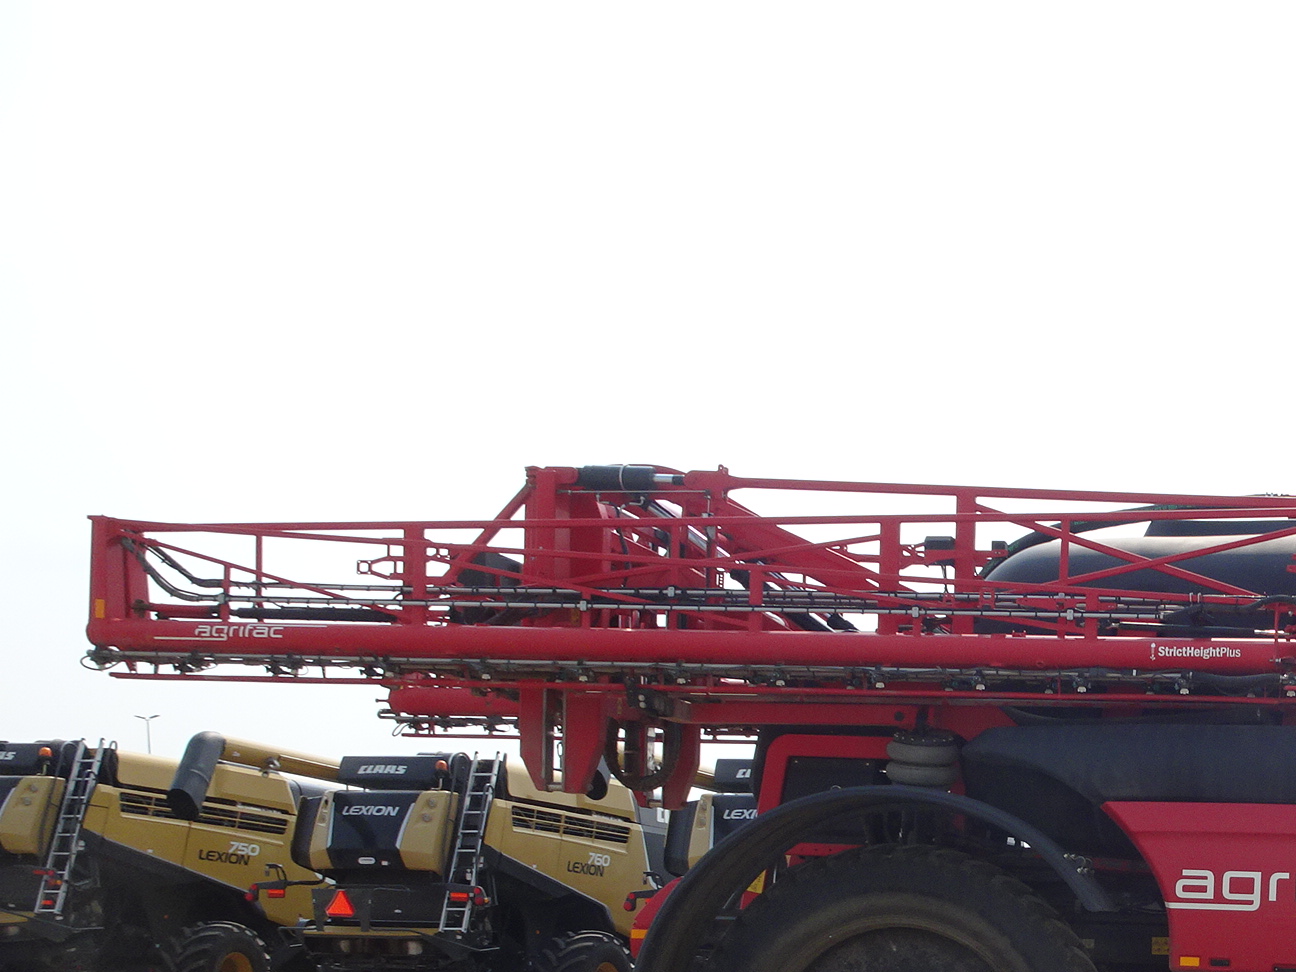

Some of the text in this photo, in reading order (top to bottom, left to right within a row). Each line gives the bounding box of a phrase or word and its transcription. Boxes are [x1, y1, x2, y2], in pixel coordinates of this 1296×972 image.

[194, 624, 285, 641] agrifac
[1157, 646, 1242, 660] StrictHeightPlus
[357, 764, 408, 775] CLAAS
[342, 805, 400, 817] LEXION
[722, 808, 759, 820] LEXI
[228, 841, 261, 857] 750
[198, 849, 251, 866] LEXION
[566, 860, 605, 877] LEXION
